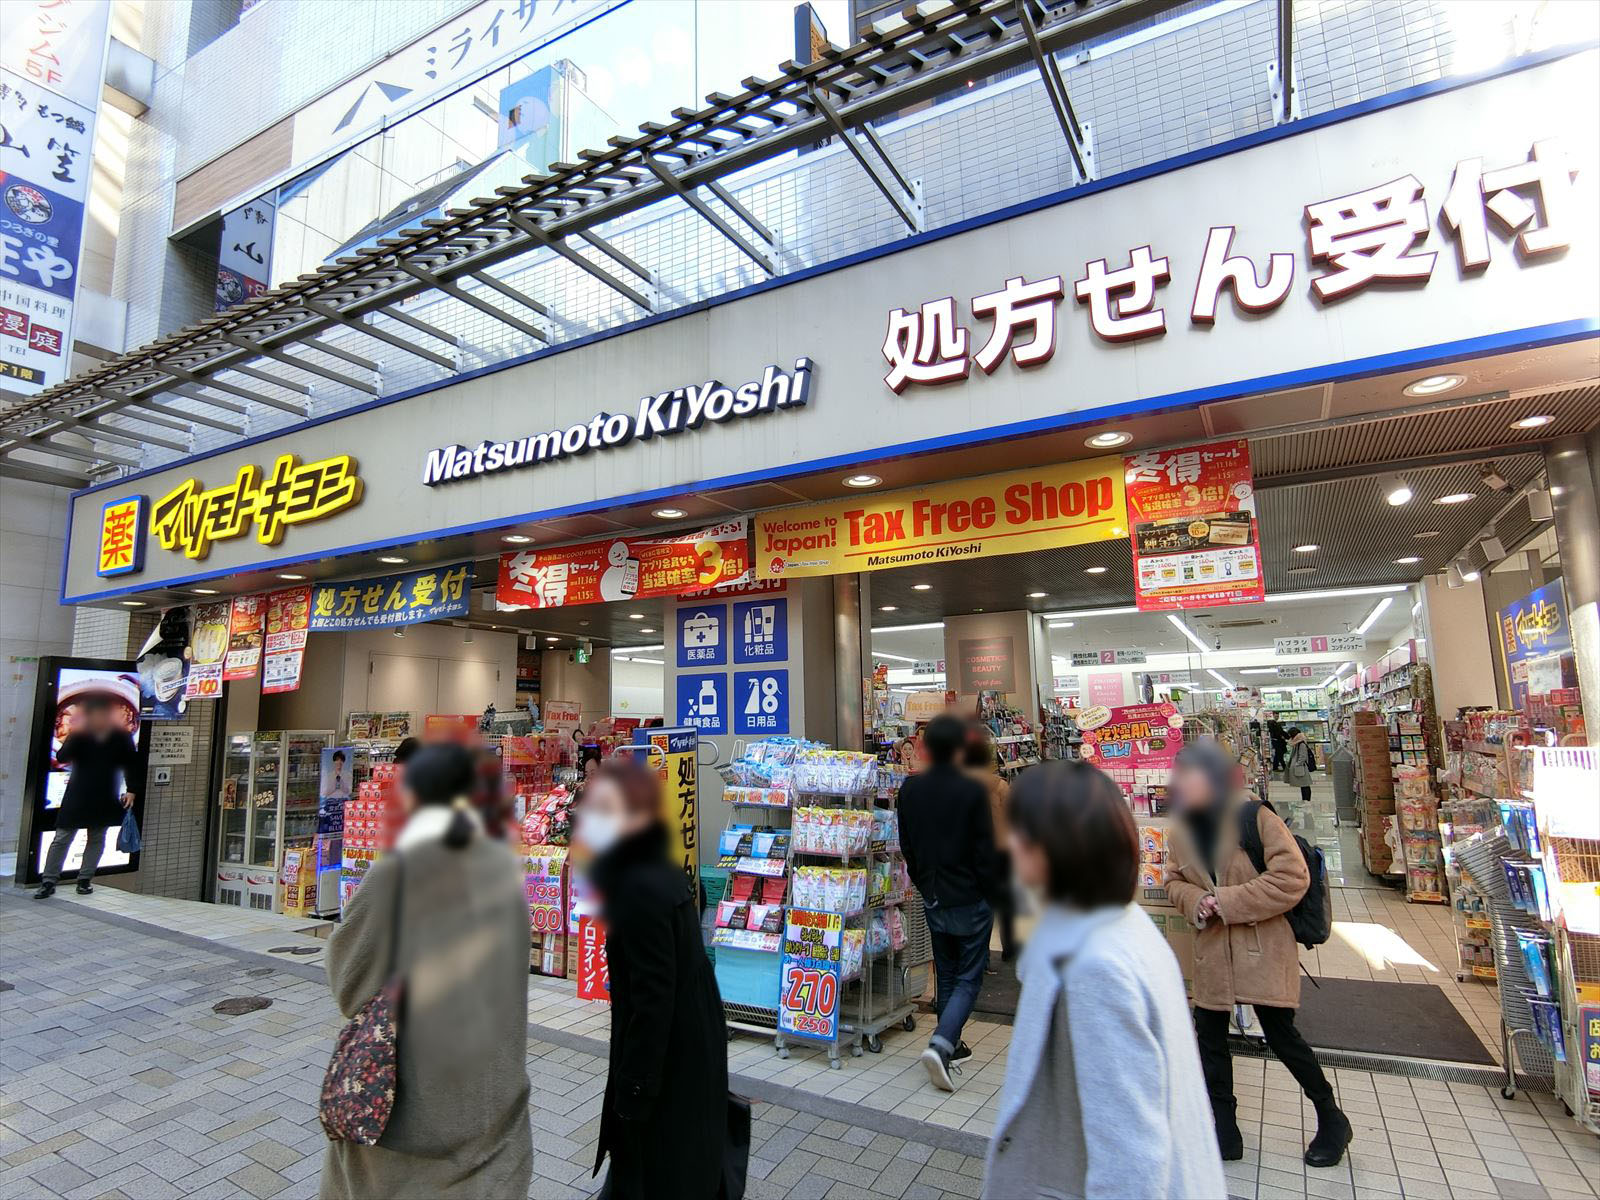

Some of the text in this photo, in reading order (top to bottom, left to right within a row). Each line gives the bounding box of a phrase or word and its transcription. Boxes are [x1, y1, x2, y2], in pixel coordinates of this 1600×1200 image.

[25, 59, 63, 83] 5F
[37, 104, 86, 135] もつ鍋
[882, 138, 1578, 393] 処方せん受付
[0, 290, 67, 320] 中国料理
[423, 357, 815, 486] Matsumoto KiYoshi
[1126, 448, 1240, 486] 冬得 セール
[151, 454, 363, 559] マツモトキヨシ
[844, 476, 1114, 546] Tax Free Shop
[103, 504, 134, 569] 薬
[763, 516, 837, 534] Welcome to
[763, 530, 837, 556] Japan!
[867, 542, 982, 566] Matsumoto KiYoshi
[641, 555, 695, 571] アプリ会員なら
[508, 551, 600, 608] 冬得 セール
[642, 567, 698, 589] 当選確率
[313, 566, 468, 617] 処方せん受付
[311, 608, 426, 628] 全国どこの処方せんでも受付致します。
[744, 643, 774, 656] 化粧品
[1331, 636, 1362, 644] シャンプー
[687, 648, 715, 660] 医薬品
[972, 665, 1002, 673] BEAUTY
[562, 711, 579, 721] Free
[683, 717, 721, 728] 健康食品
[746, 715, 777, 727] 日用品
[1094, 721, 1169, 742] 乾燥肌には
[652, 736, 669, 753] 薬
[677, 756, 697, 903] 処方せん
[526, 884, 560, 900] 198
[584, 919, 597, 993] ロテイン!!
[786, 967, 838, 1017] 270
[797, 1014, 831, 1036] 250
